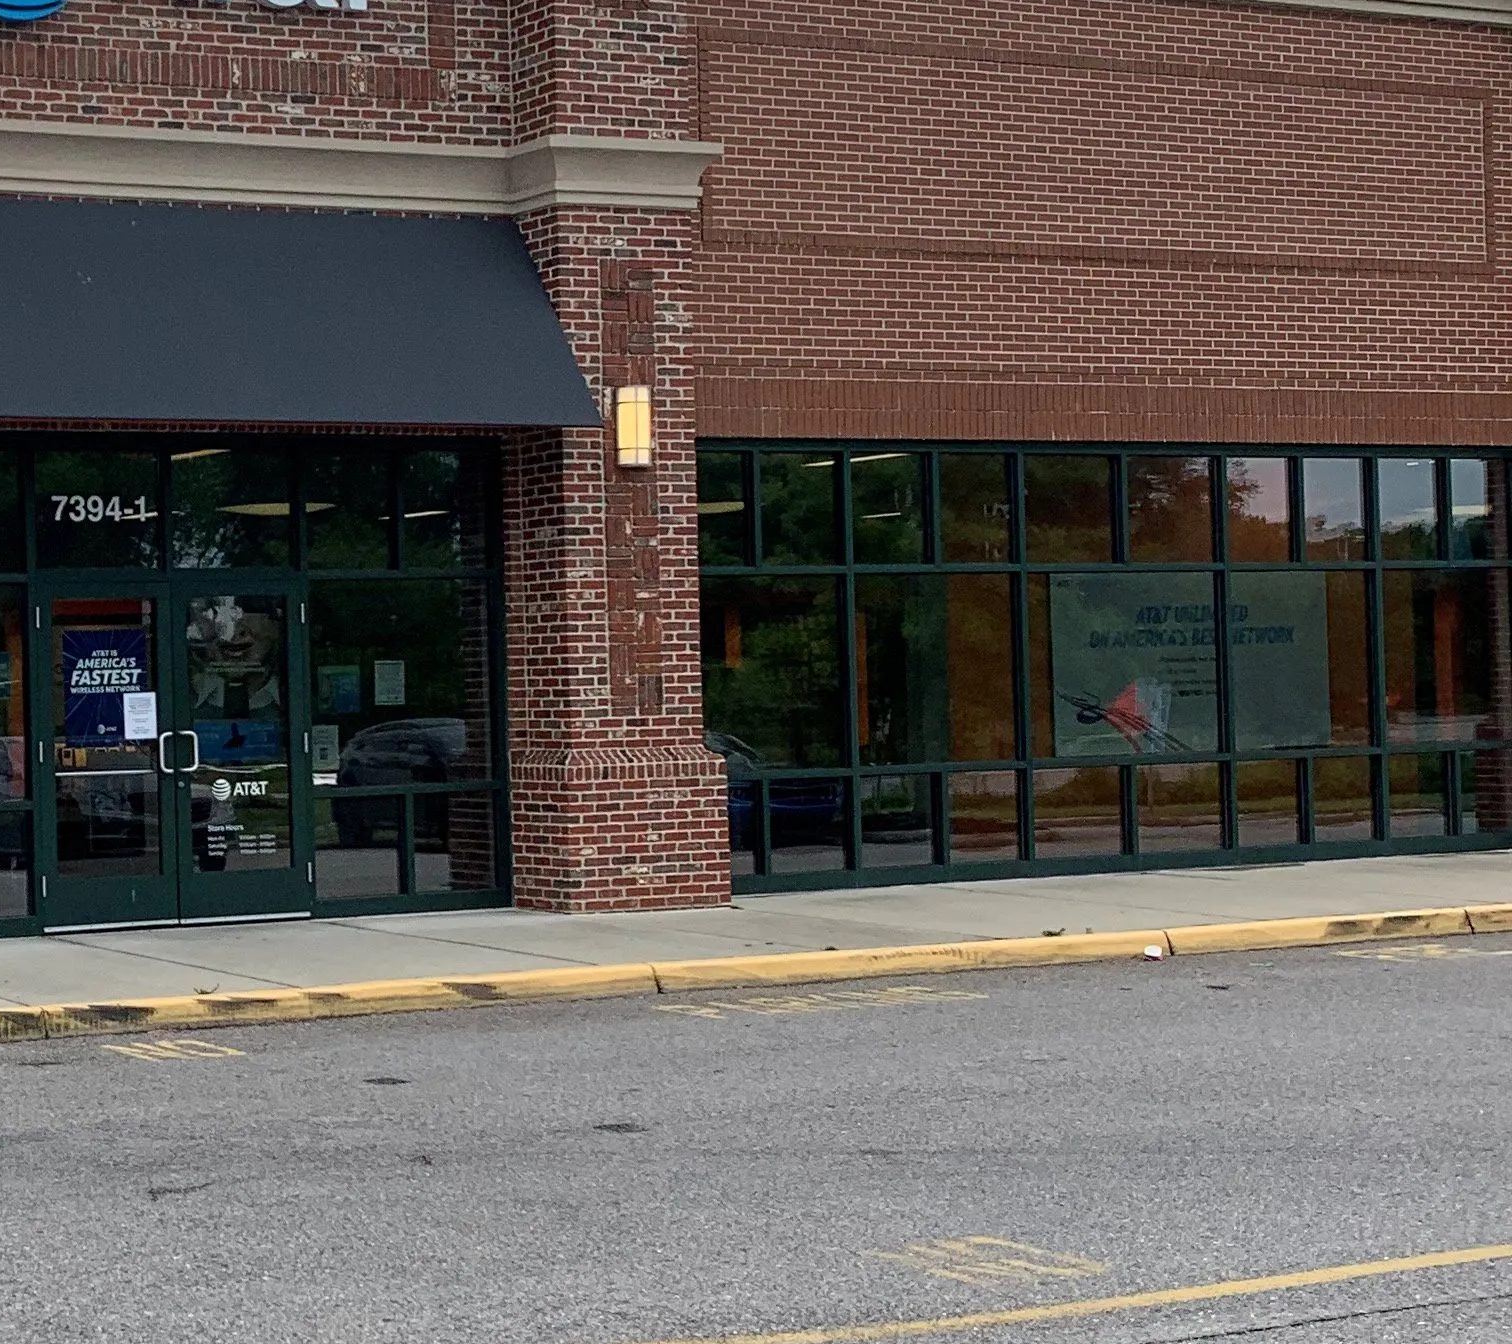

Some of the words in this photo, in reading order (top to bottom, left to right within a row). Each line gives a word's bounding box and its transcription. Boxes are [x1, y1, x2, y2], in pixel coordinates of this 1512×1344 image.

[51, 495, 146, 522] 7394-1
[75, 657, 137, 669] AMERICA'S
[70, 668, 143, 686] FASTEST
[70, 686, 105, 694] WIRELESS
[105, 685, 141, 693] NETWORK
[233, 780, 269, 796] AT&T
